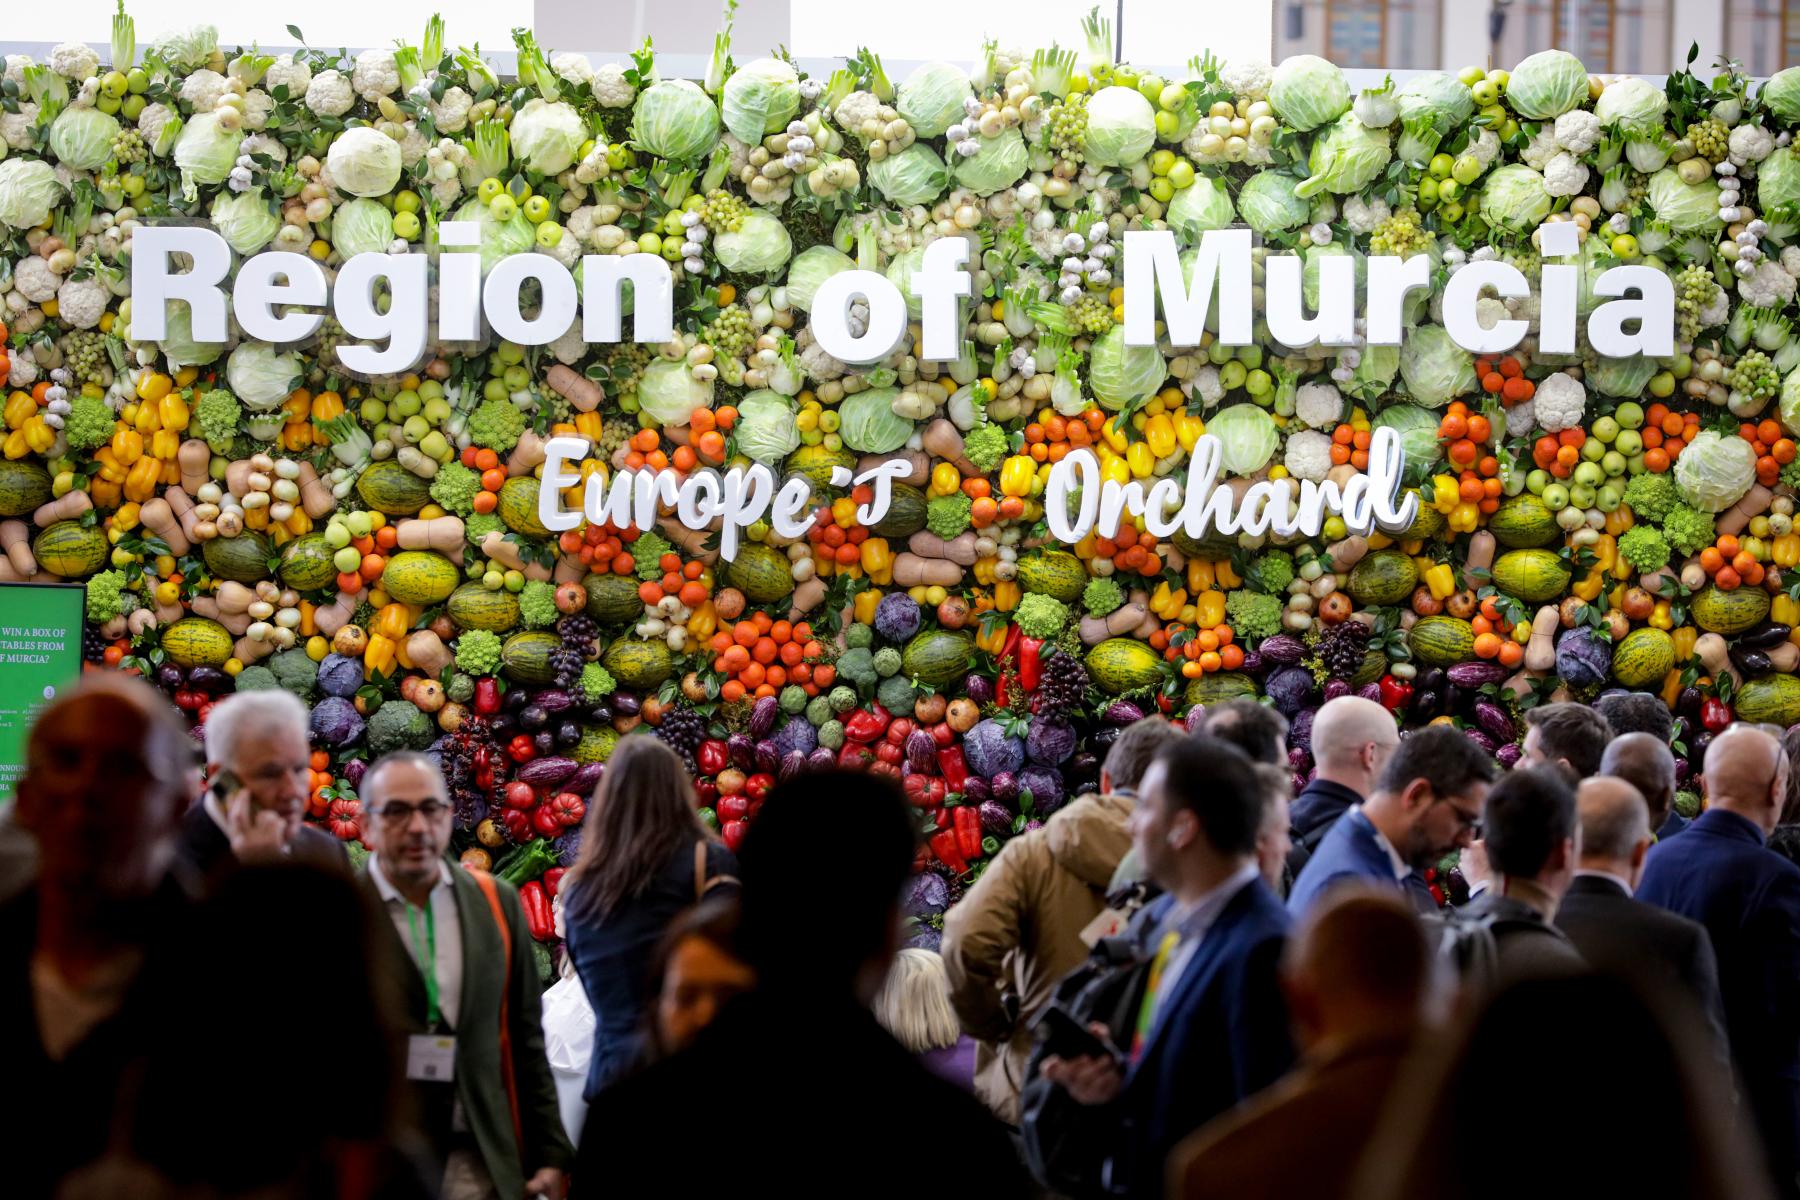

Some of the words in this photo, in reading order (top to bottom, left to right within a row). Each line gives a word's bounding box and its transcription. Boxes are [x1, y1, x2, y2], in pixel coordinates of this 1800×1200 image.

[130, 214, 676, 375] Region
[810, 236, 973, 362] of
[1122, 216, 1676, 358] Murcia
[1045, 425, 1420, 544] Orchard
[2, 627, 22, 637] WIN
[23, 628, 31, 637] A
[32, 628, 51, 638] BOX
[52, 629, 66, 638] OF
[37, 641, 65, 651] FROM
[7, 654, 50, 664] MURCIA?
